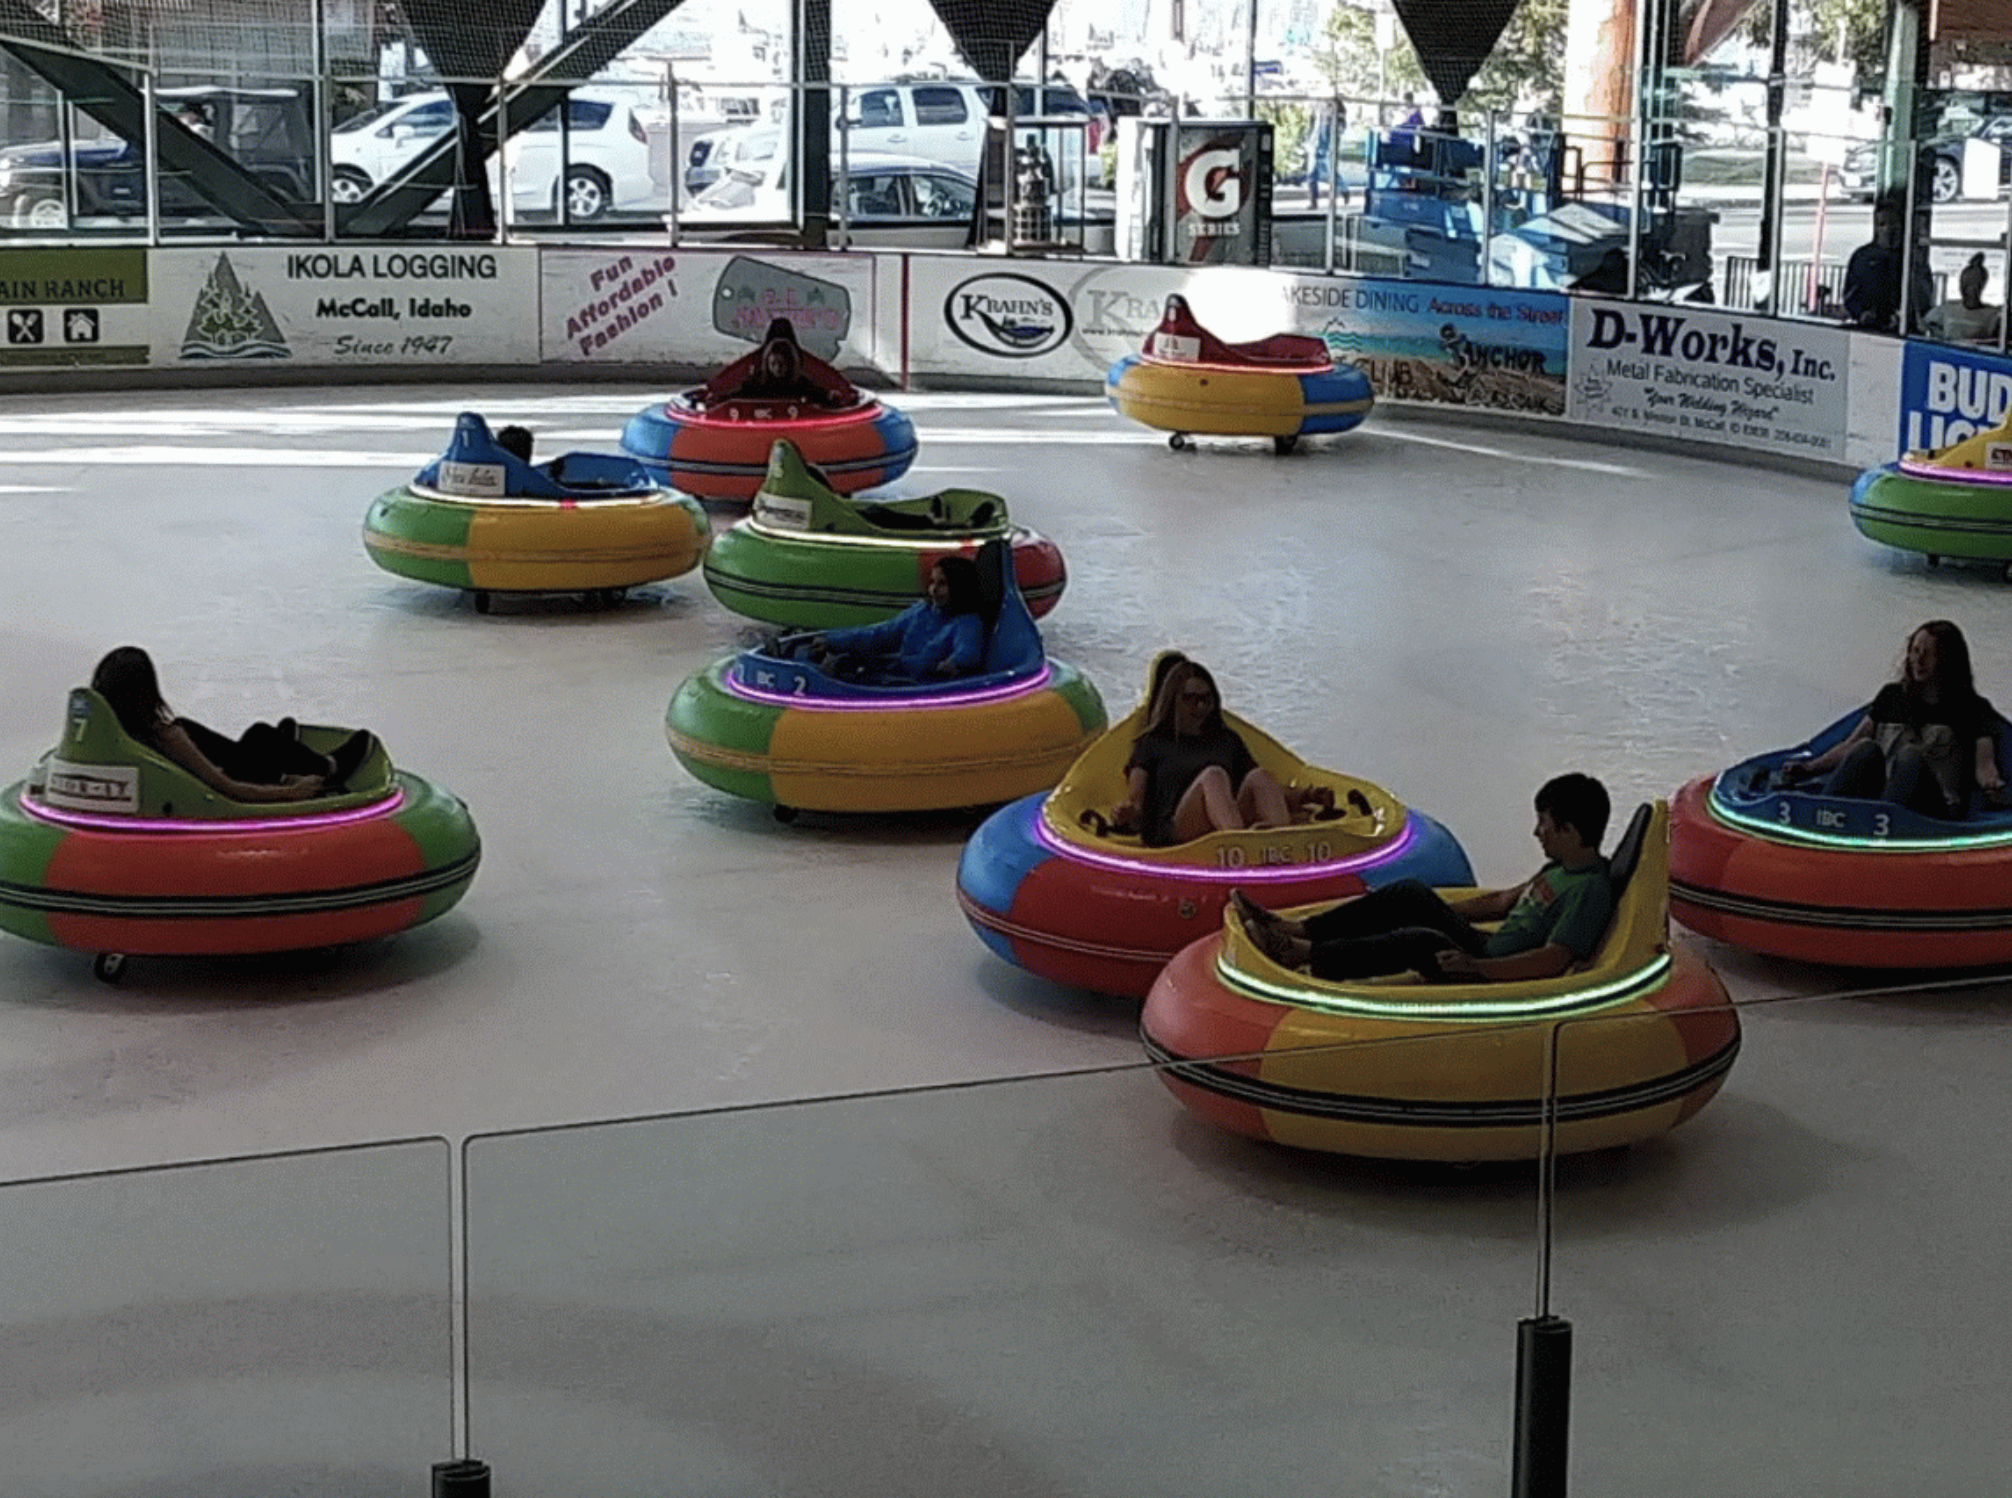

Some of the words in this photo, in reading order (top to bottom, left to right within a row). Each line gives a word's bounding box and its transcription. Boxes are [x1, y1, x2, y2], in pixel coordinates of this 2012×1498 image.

[1185, 149, 1240, 218] G
[1188, 222, 1240, 236] SERIES
[287, 254, 366, 279] IKOLA
[373, 253, 497, 279] LOGGING
[590, 256, 633, 291] Fun
[45, 279, 125, 298] RANCH
[566, 256, 676, 340] Affordable
[315, 298, 401, 321] McCall,
[408, 298, 472, 318] Idaho
[959, 294, 1054, 320] KRAHN'S
[1355, 290, 1420, 314] DINING
[1427, 297, 1481, 318] Across
[1487, 301, 1512, 320] the
[578, 291, 664, 356] Fashion
[334, 335, 395, 355] Since
[400, 335, 453, 355] 1947
[1586, 308, 1785, 382] D-Works,
[1790, 348, 1836, 382] Inc.
[1606, 357, 1650, 381] Metal
[1653, 364, 1739, 393] Fabrication
[1743, 377, 1815, 405] Specialist
[1928, 360, 2012, 425] BUD
[793, 675, 807, 696] 2
[74, 718, 87, 742] 7
[1779, 803, 1792, 825] 3
[1816, 810, 1846, 828] IBC
[1873, 814, 1890, 836] 3
[1216, 847, 1246, 868] 10
[1307, 842, 1332, 863] 10
